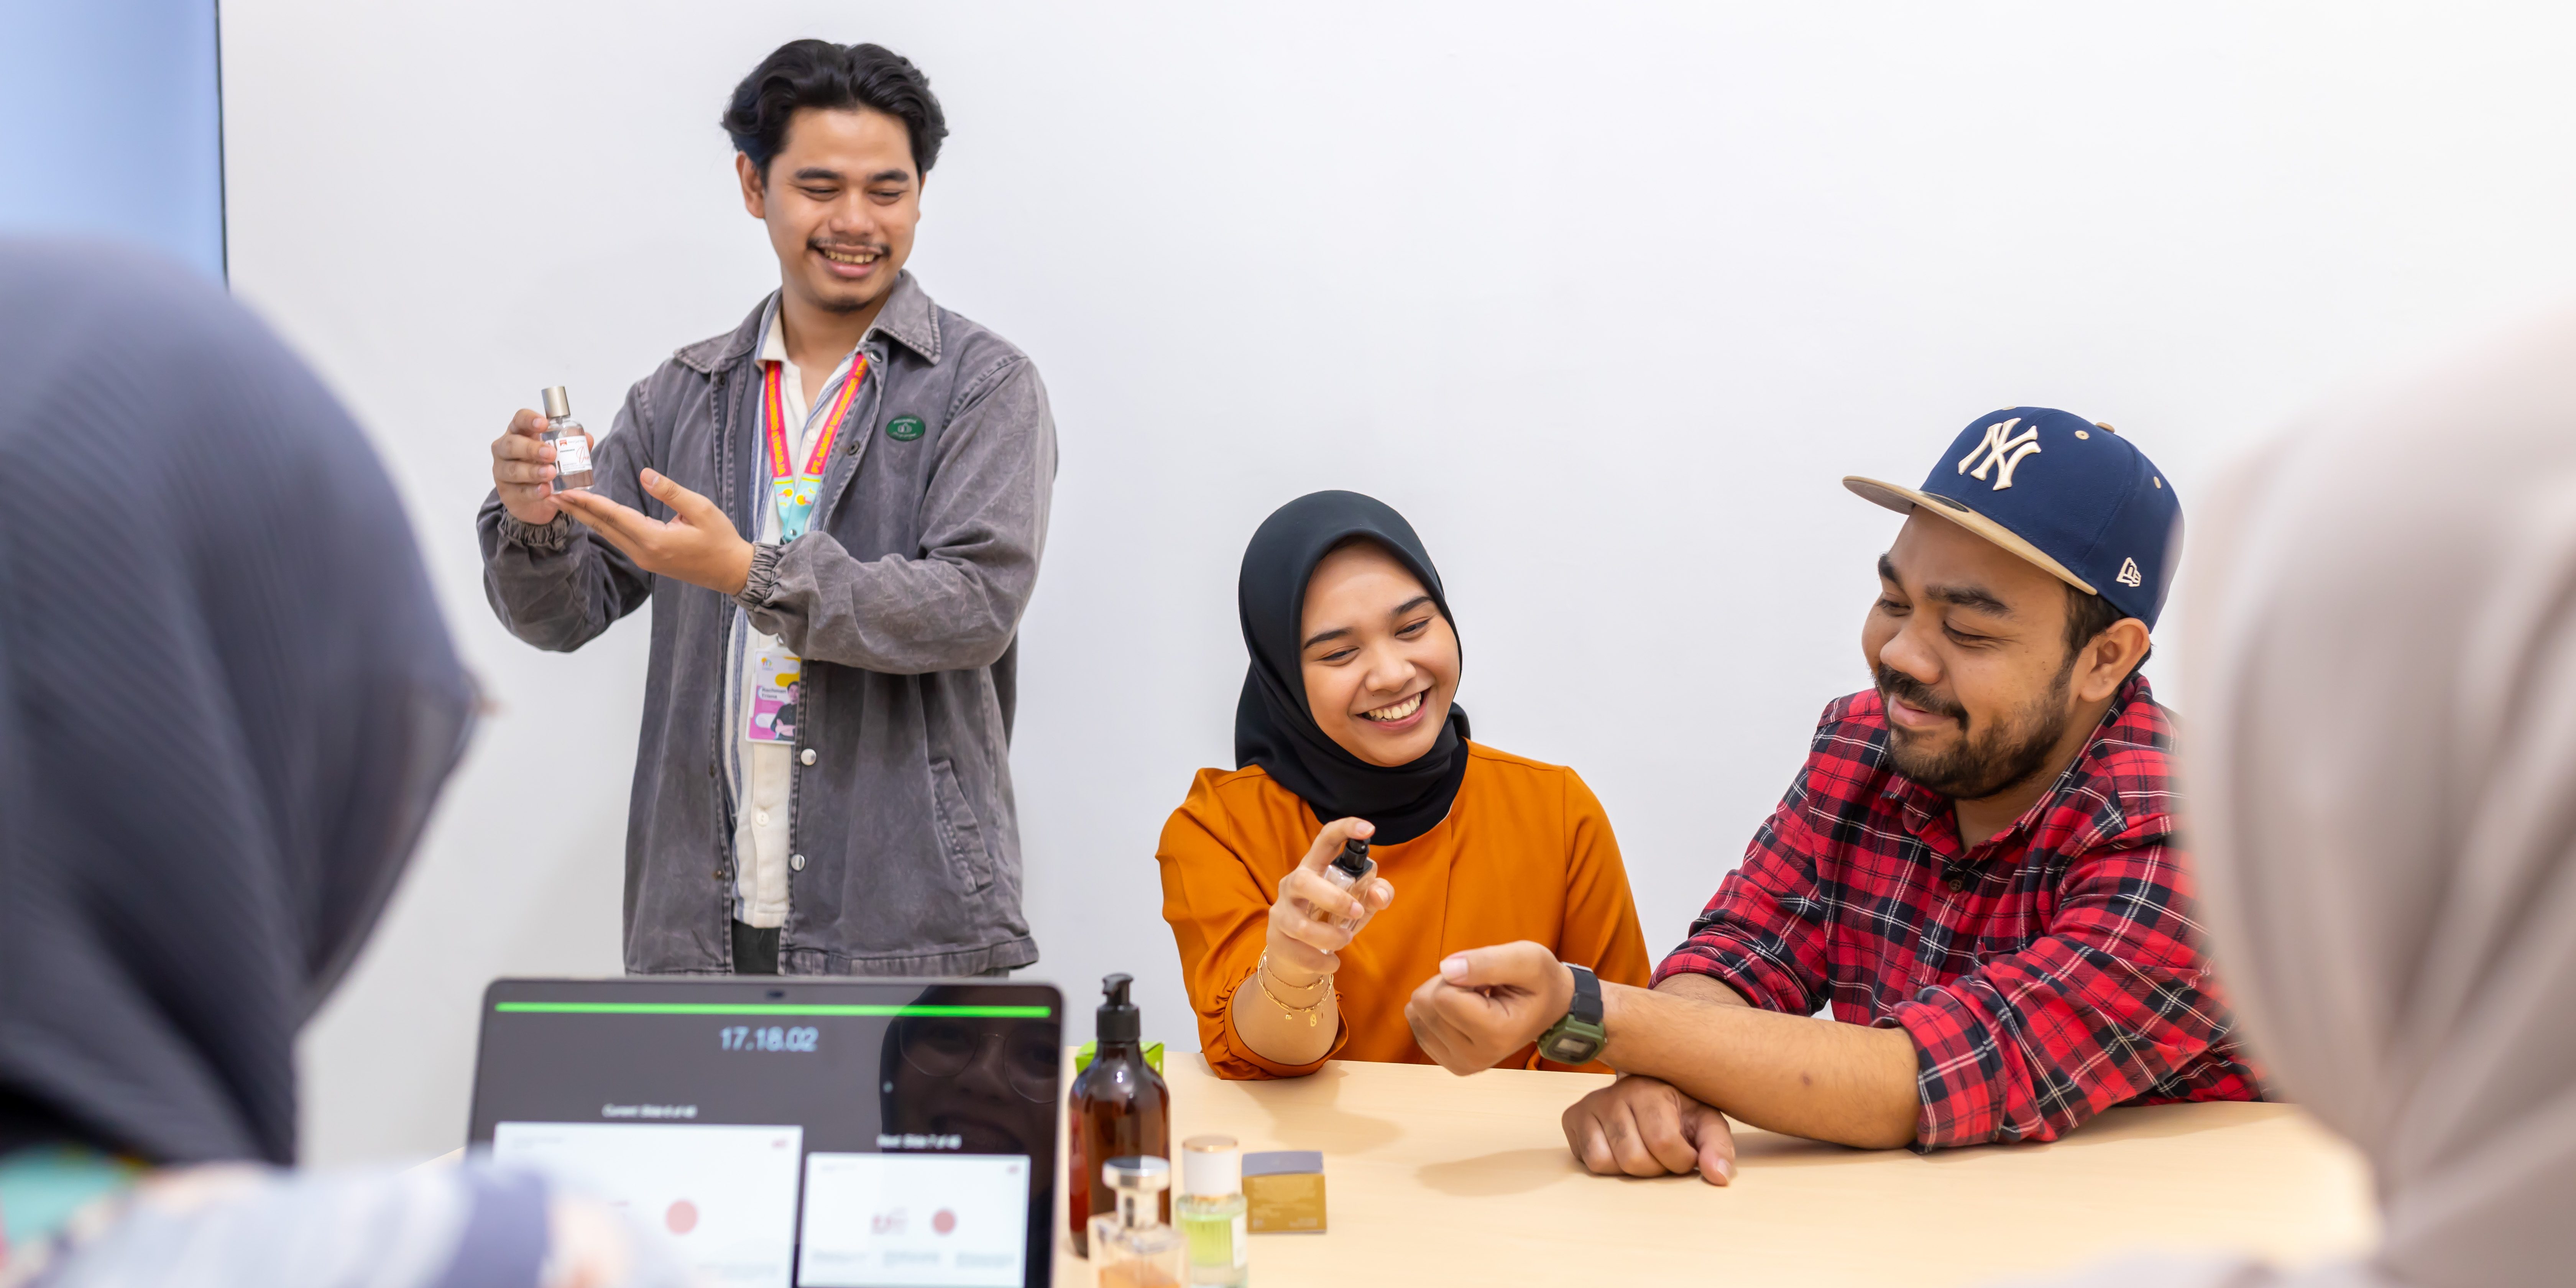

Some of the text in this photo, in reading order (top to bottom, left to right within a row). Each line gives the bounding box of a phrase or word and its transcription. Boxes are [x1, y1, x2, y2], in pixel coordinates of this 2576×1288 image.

[771, 430, 785, 476] ATMADJA
[811, 458, 823, 473] PT.
[1958, 417, 2042, 490] NY
[719, 1026, 819, 1052] 17.18.02
